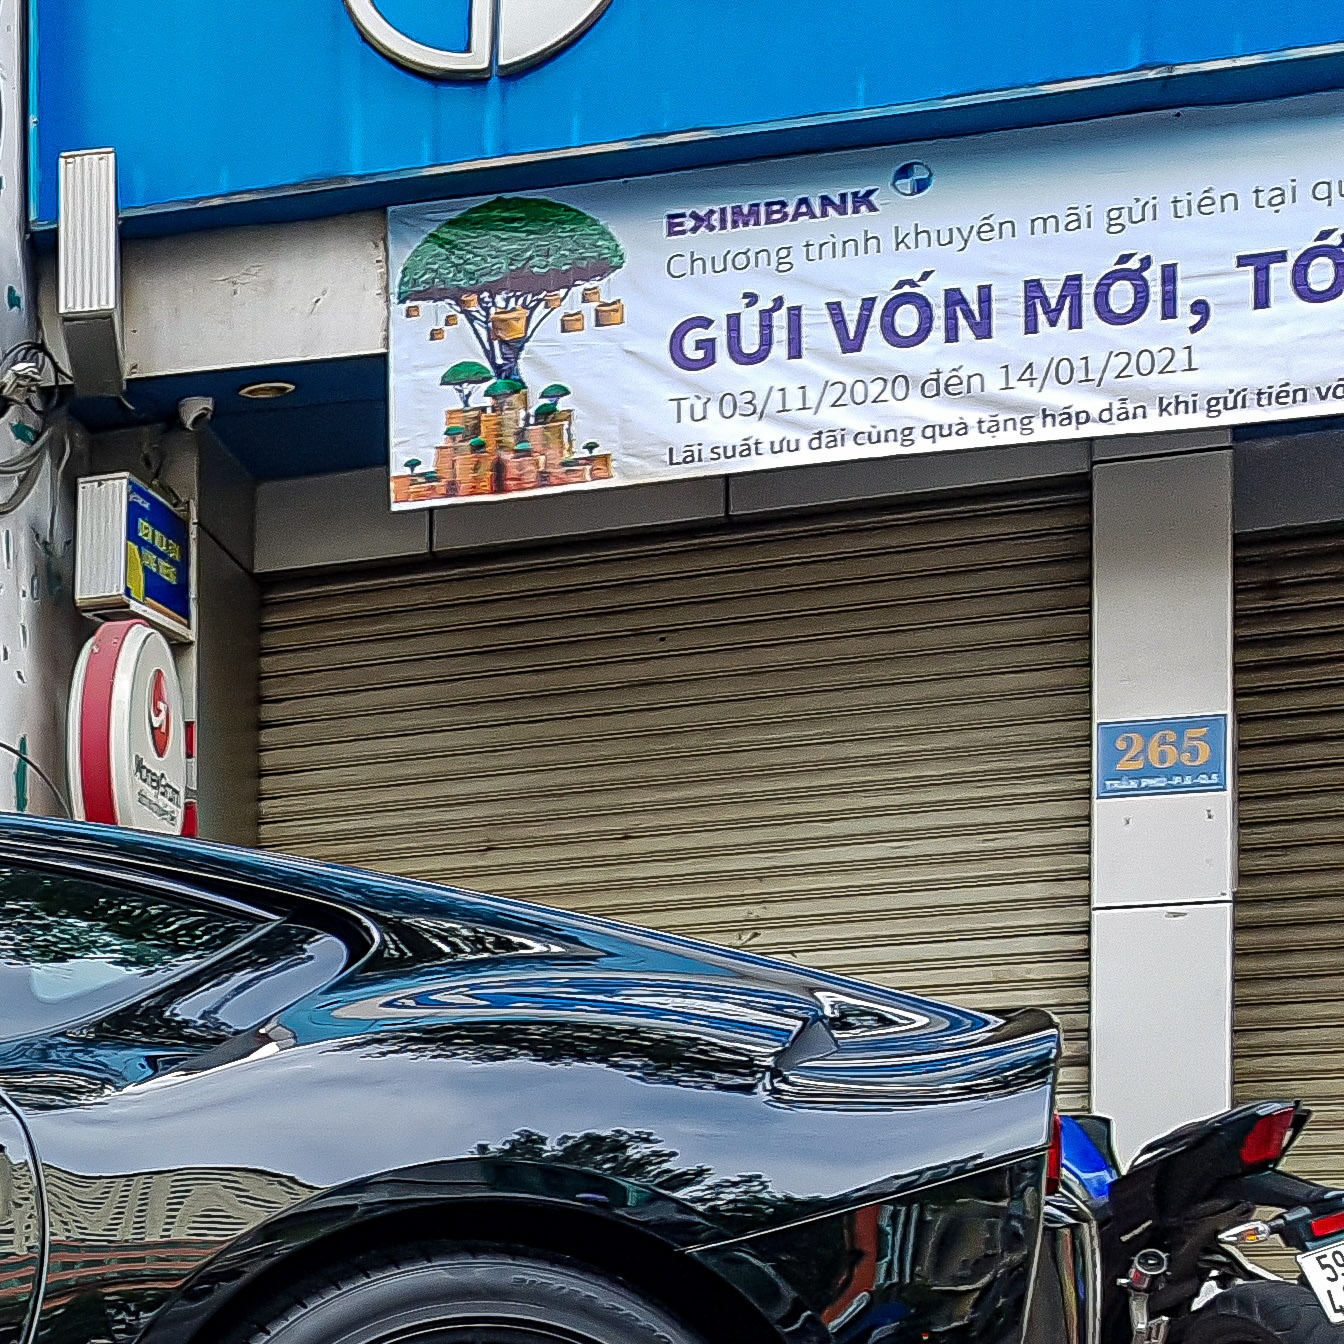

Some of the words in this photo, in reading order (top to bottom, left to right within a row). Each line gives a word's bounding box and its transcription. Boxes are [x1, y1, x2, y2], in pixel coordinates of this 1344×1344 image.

[666, 187, 880, 237] EXIMBANK
[666, 248, 794, 279] Chương
[803, 230, 881, 262] trình
[894, 213, 1016, 252] khuyến
[1030, 204, 1092, 235] mãi
[1106, 197, 1157, 234] gửi
[1253, 179, 1297, 214] tại
[669, 291, 803, 371] GỬI
[825, 270, 993, 354] VỐN
[1023, 252, 1211, 335] MỚI,
[669, 394, 711, 424] Từ
[718, 374, 911, 421] 03/11/2020
[920, 365, 985, 399] đến
[999, 345, 1200, 392] 14/01/2021
[667, 443, 704, 467] Lãi
[710, 436, 763, 461] suất
[770, 438, 800, 455] ưu
[808, 427, 847, 451] đãi
[853, 422, 914, 448] cùng
[921, 415, 969, 444] quà
[977, 411, 1035, 438] tặng
[1042, 404, 1090, 430] hấp
[1098, 398, 1147, 423] dẫn
[1158, 393, 1198, 417] khi
[1206, 387, 1248, 418] gửi
[1115, 727, 1211, 771] 265
